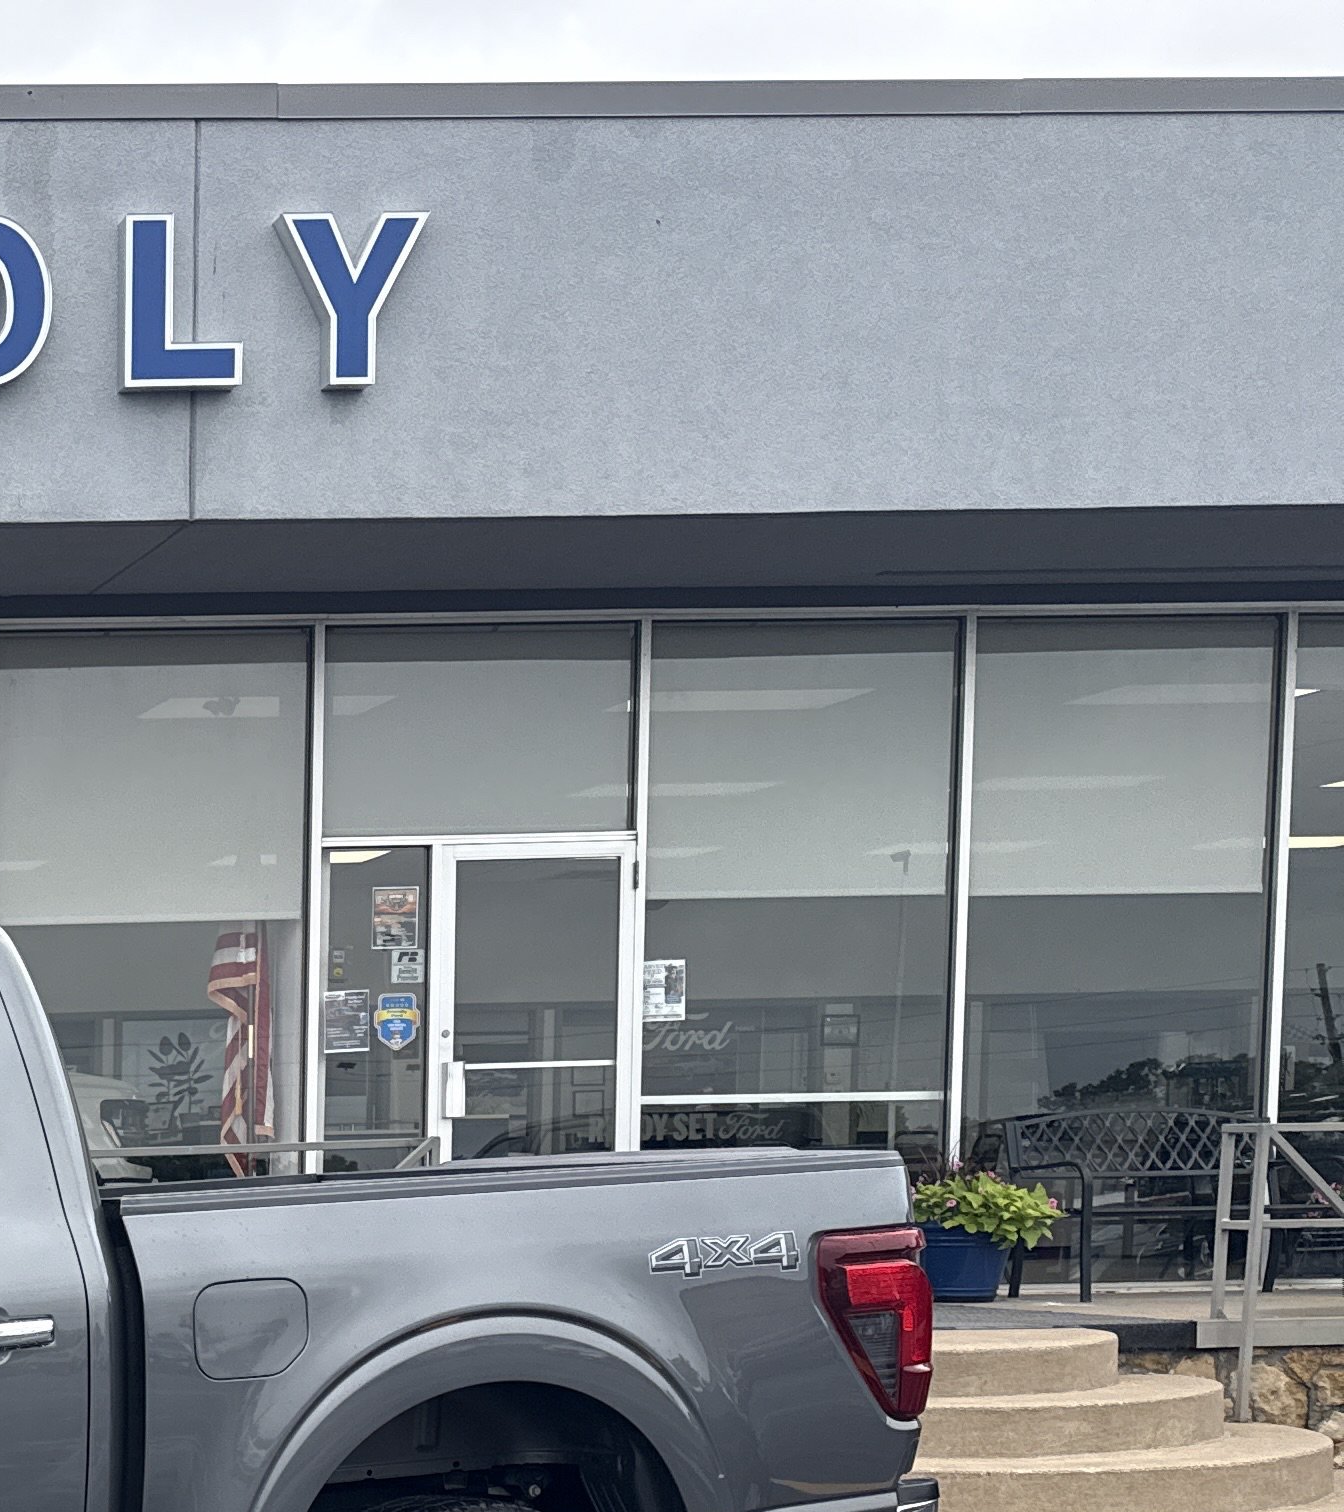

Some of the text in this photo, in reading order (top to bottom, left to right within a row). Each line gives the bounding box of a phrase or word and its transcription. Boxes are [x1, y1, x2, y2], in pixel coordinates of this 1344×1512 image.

[642, 1011, 733, 1051] Ford
[673, 1113, 717, 1151] SET
[718, 1111, 783, 1150] Ford
